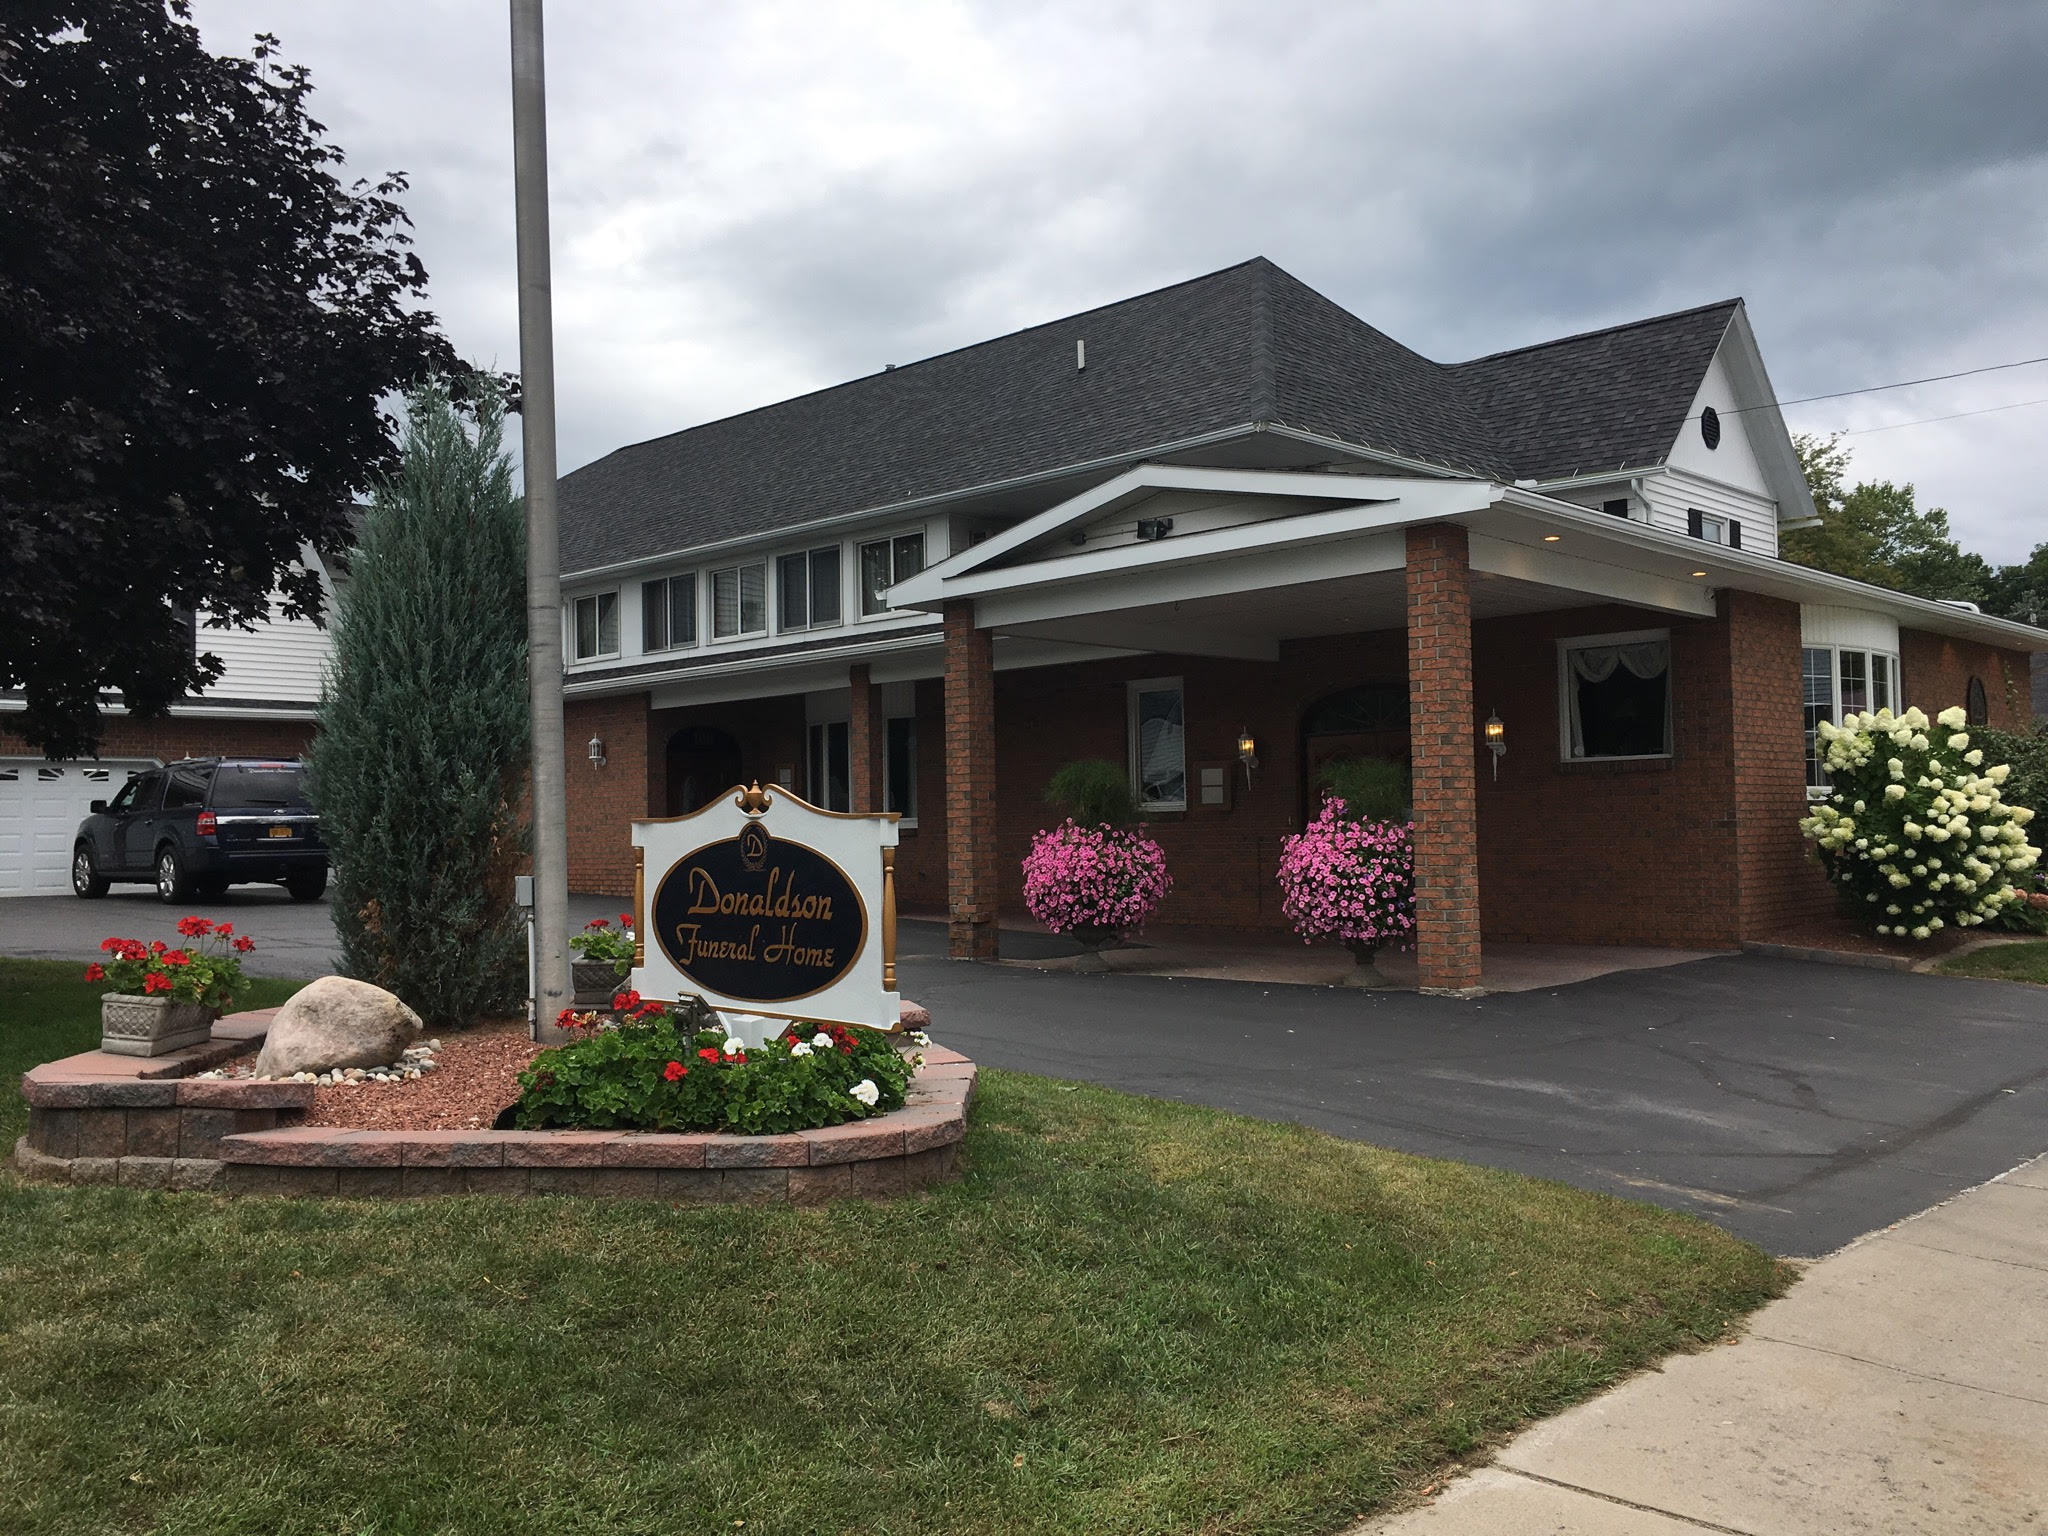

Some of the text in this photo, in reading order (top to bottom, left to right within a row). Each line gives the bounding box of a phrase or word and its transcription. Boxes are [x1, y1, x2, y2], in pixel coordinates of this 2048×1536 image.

[747, 834, 763, 857] D
[688, 866, 833, 920] Donaldson
[676, 922, 835, 967] Funeral Home
